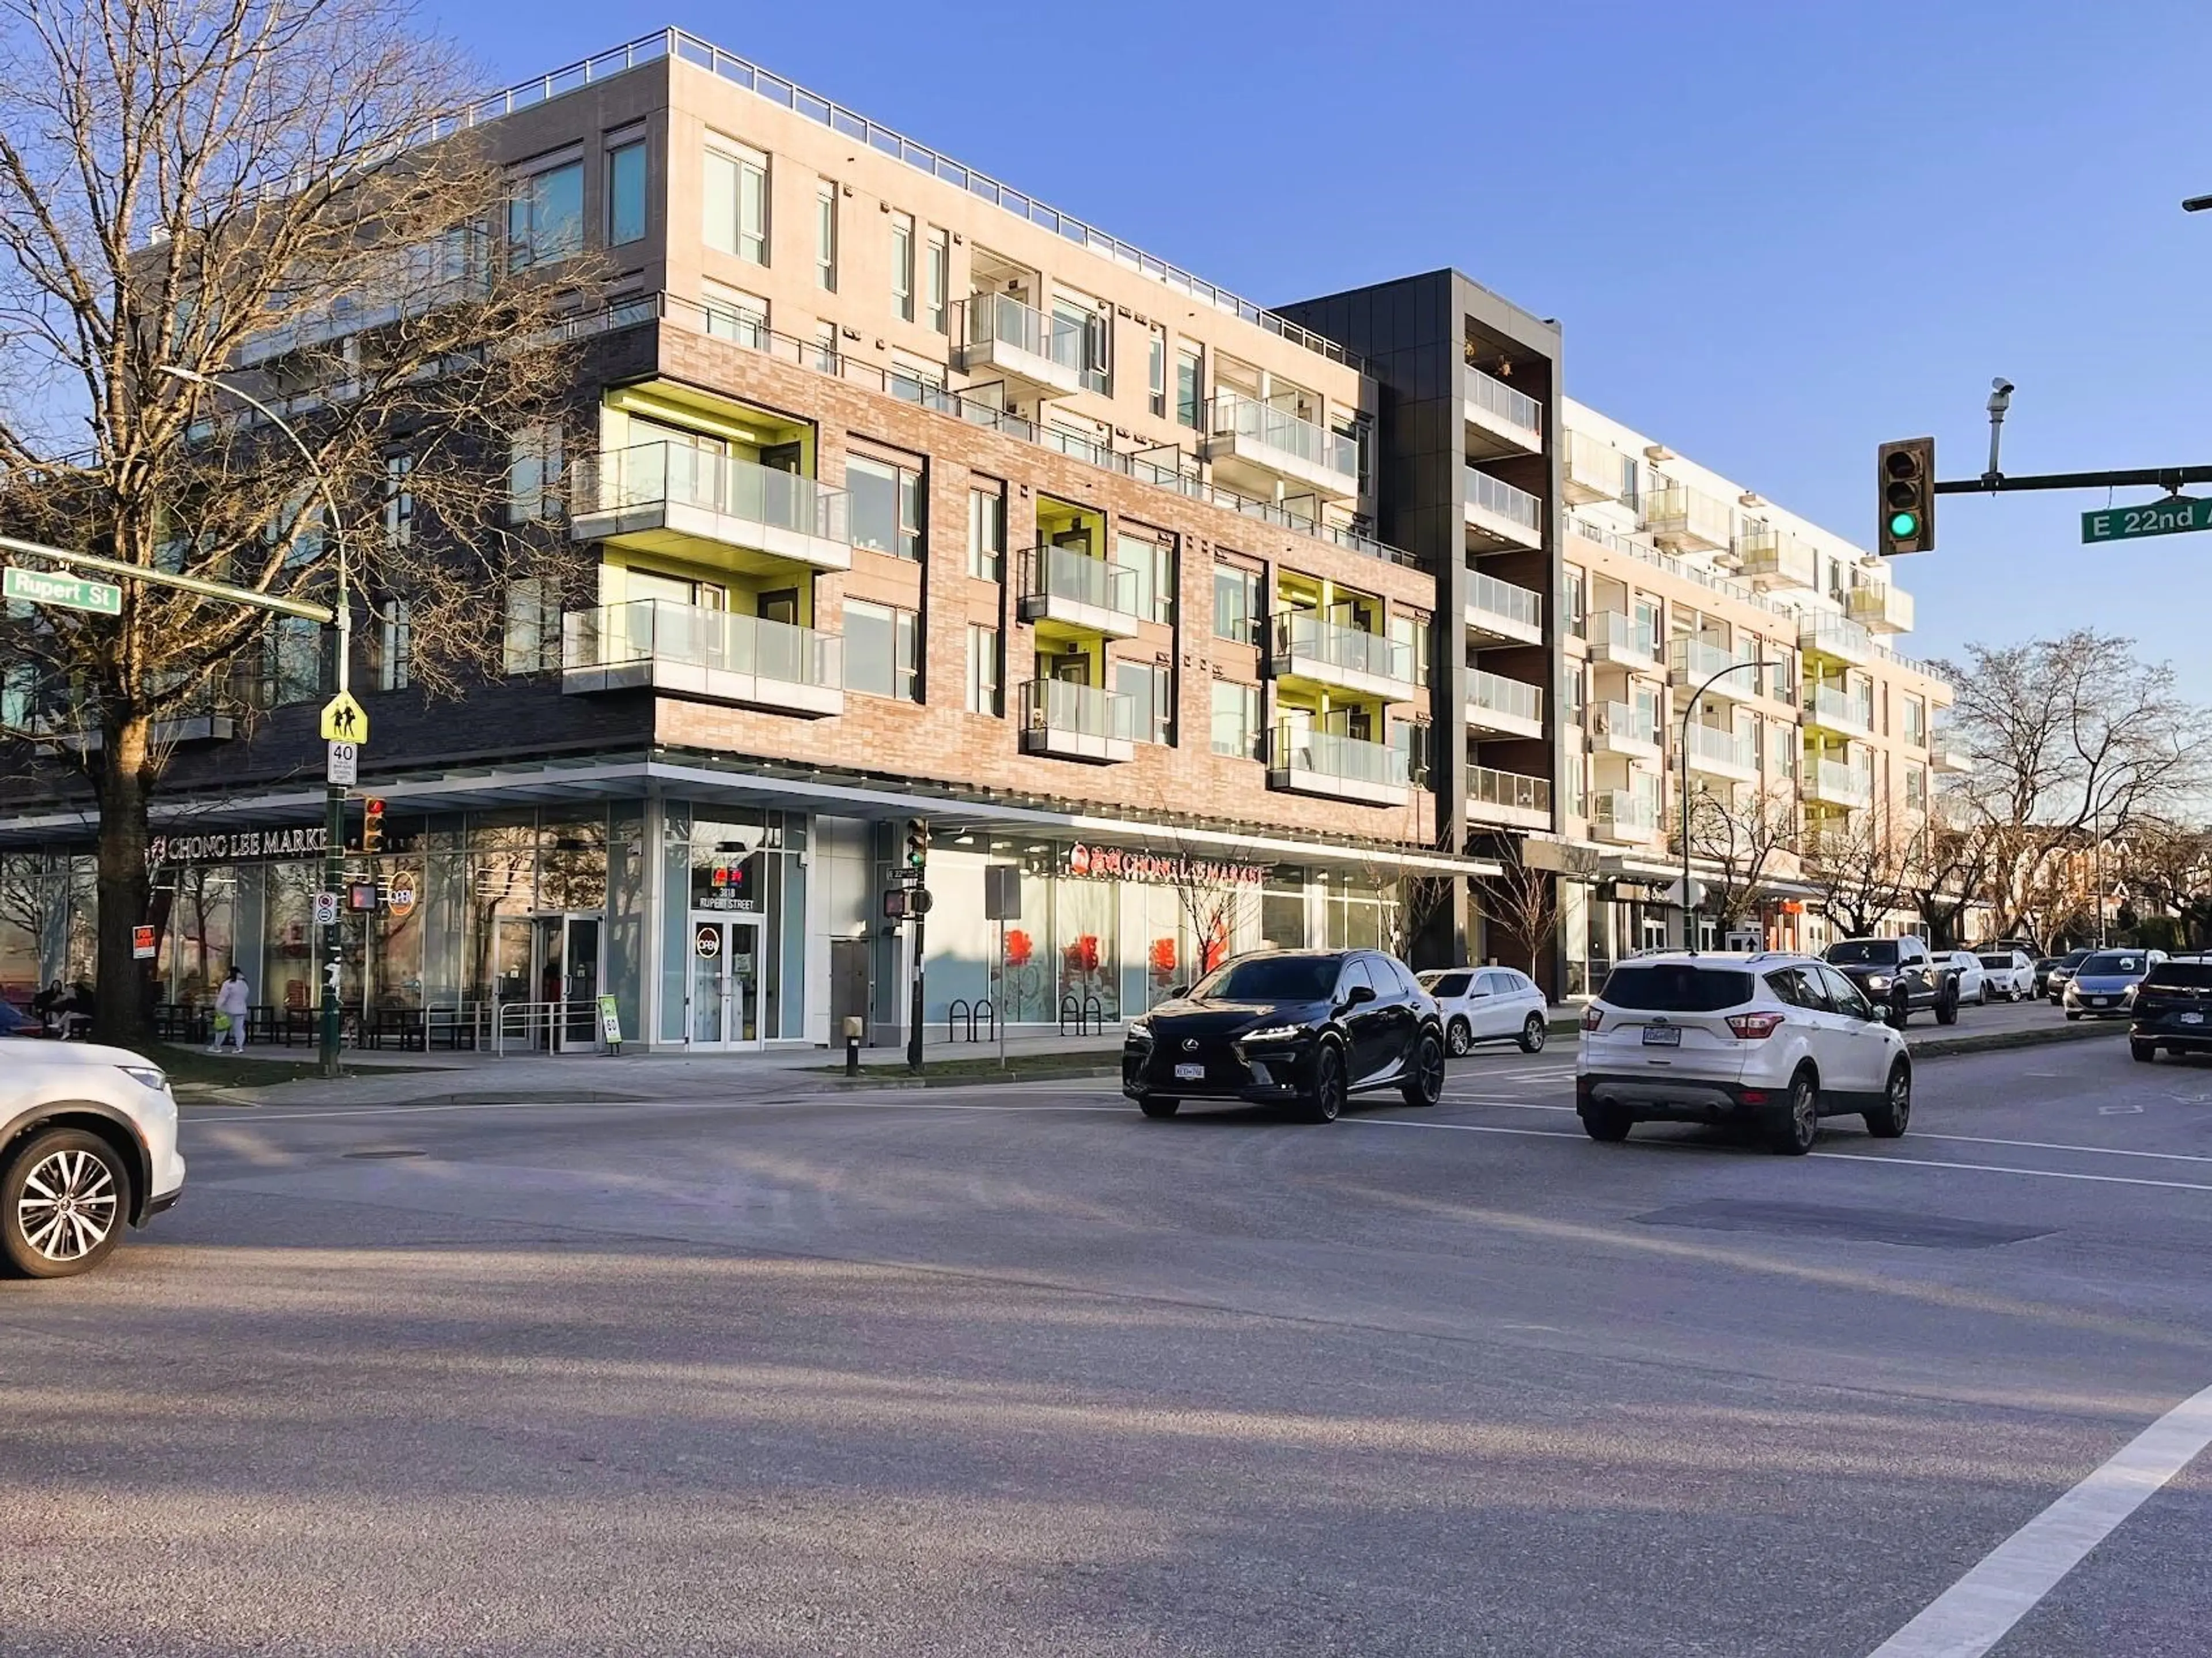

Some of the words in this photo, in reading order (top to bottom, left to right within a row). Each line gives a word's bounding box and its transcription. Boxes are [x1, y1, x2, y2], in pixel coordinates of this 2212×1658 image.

[2093, 515, 2110, 536] E
[2124, 506, 2193, 533] 22nd
[15, 572, 81, 601] Rupert
[89, 586, 110, 606] St
[334, 745, 352, 760] 40
[168, 834, 227, 859] CHONG
[230, 833, 260, 856] LEE
[263, 828, 327, 854] MARKE
[700, 897, 726, 909] RUPERT
[728, 899, 753, 910] STREET
